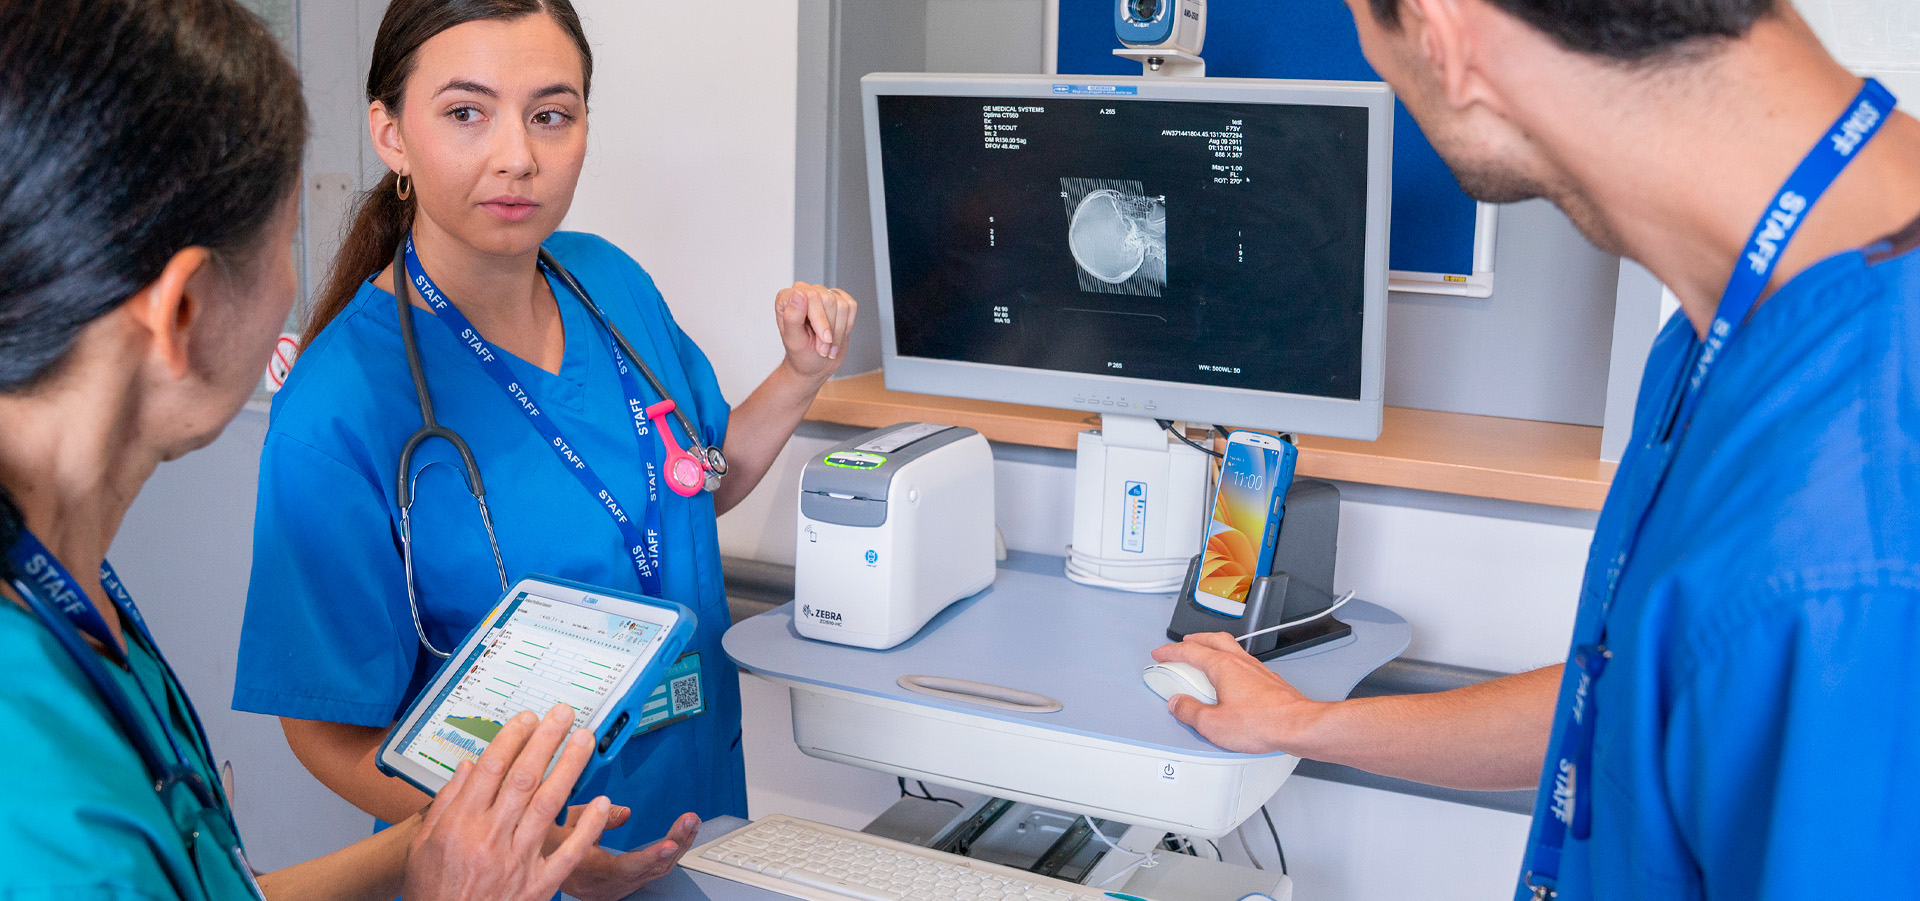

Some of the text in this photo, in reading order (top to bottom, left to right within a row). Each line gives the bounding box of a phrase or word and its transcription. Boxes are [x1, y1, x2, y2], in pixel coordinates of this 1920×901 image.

[1830, 99, 1880, 157] STAFF
[1746, 190, 1807, 275] STAFF
[416, 274, 448, 309] STAFF
[461, 328, 494, 363] STAFF
[508, 382, 540, 418] STAFF
[629, 398, 649, 436] STAFF
[553, 437, 586, 470] STAFF
[647, 462, 657, 502] STAFF
[1234, 471, 1262, 490] 11:00
[599, 489, 628, 524] STAFF
[632, 545, 652, 578] STAFF
[25, 554, 87, 614] STAFF
[816, 609, 842, 621] ZEBRA
[1572, 672, 1590, 725] TAFF
[1551, 757, 1576, 828] STAFF
